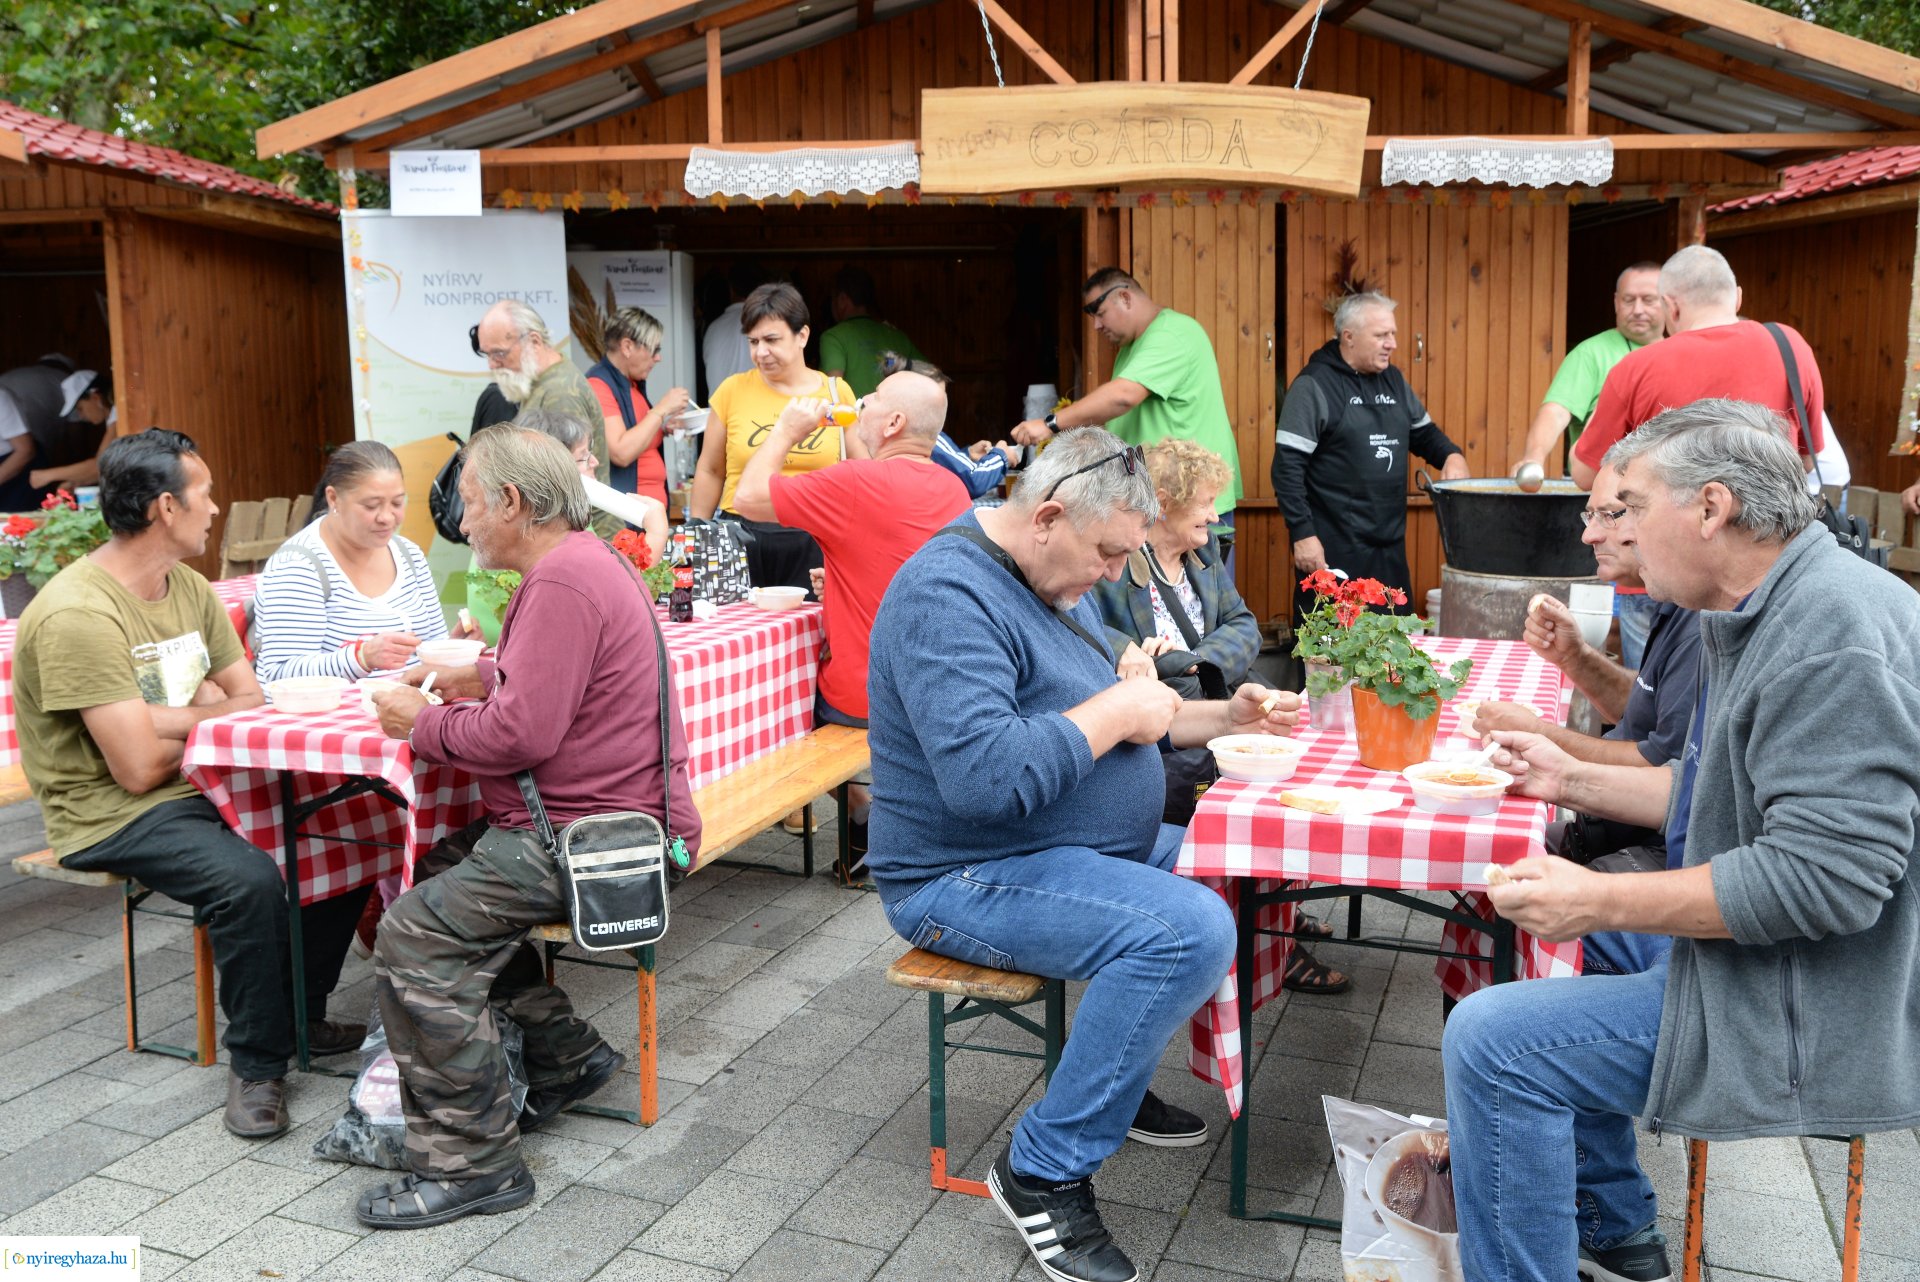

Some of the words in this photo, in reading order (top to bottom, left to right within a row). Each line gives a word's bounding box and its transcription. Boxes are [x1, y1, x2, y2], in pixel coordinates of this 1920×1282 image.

[1029, 108, 1252, 169] CSÁRDA
[423, 270, 483, 287] NYÍRVV
[524, 290, 558, 304] KFT.
[589, 915, 659, 935] CONVERSE
[1053, 1182, 1081, 1193] adidas
